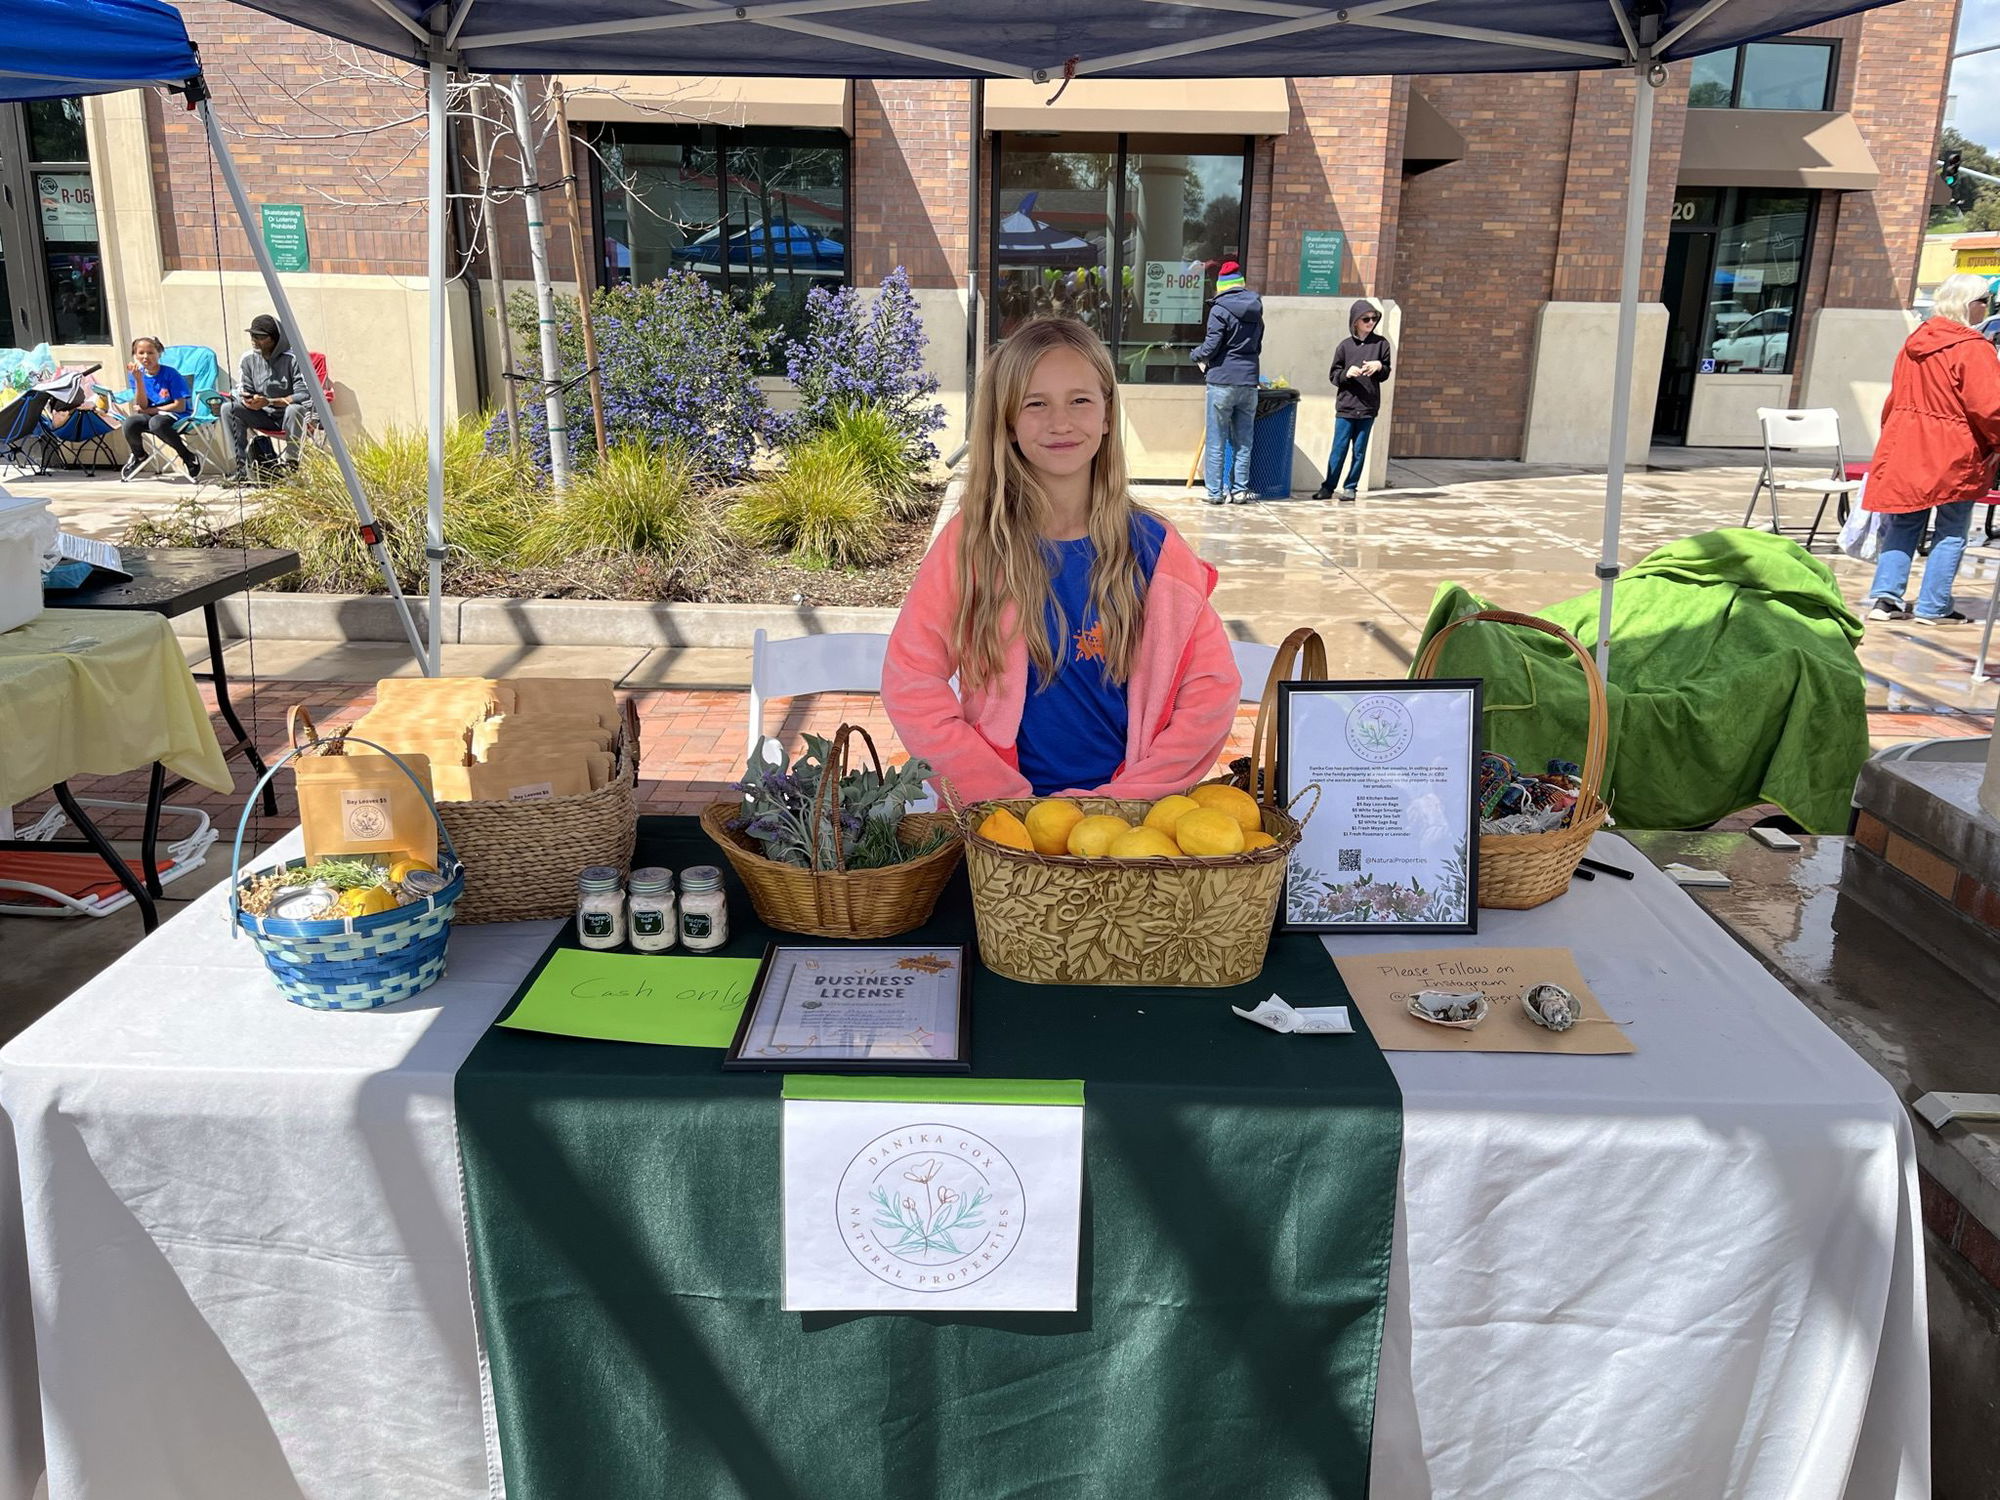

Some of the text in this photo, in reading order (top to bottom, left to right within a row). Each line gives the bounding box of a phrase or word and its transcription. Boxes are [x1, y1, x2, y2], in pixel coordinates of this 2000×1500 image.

[1166, 274, 1200, 289] R-082
[1378, 966, 1428, 977] Please
[1436, 961, 1488, 975] Follow
[814, 976, 916, 986] BUSINESS
[1417, 978, 1506, 992] Instagram
[570, 978, 752, 1011] Cash only
[820, 988, 906, 999] LICENSE
[868, 1134, 992, 1168] DANIKA COX
[851, 1207, 1008, 1284] NATURAL PROPERTIES
